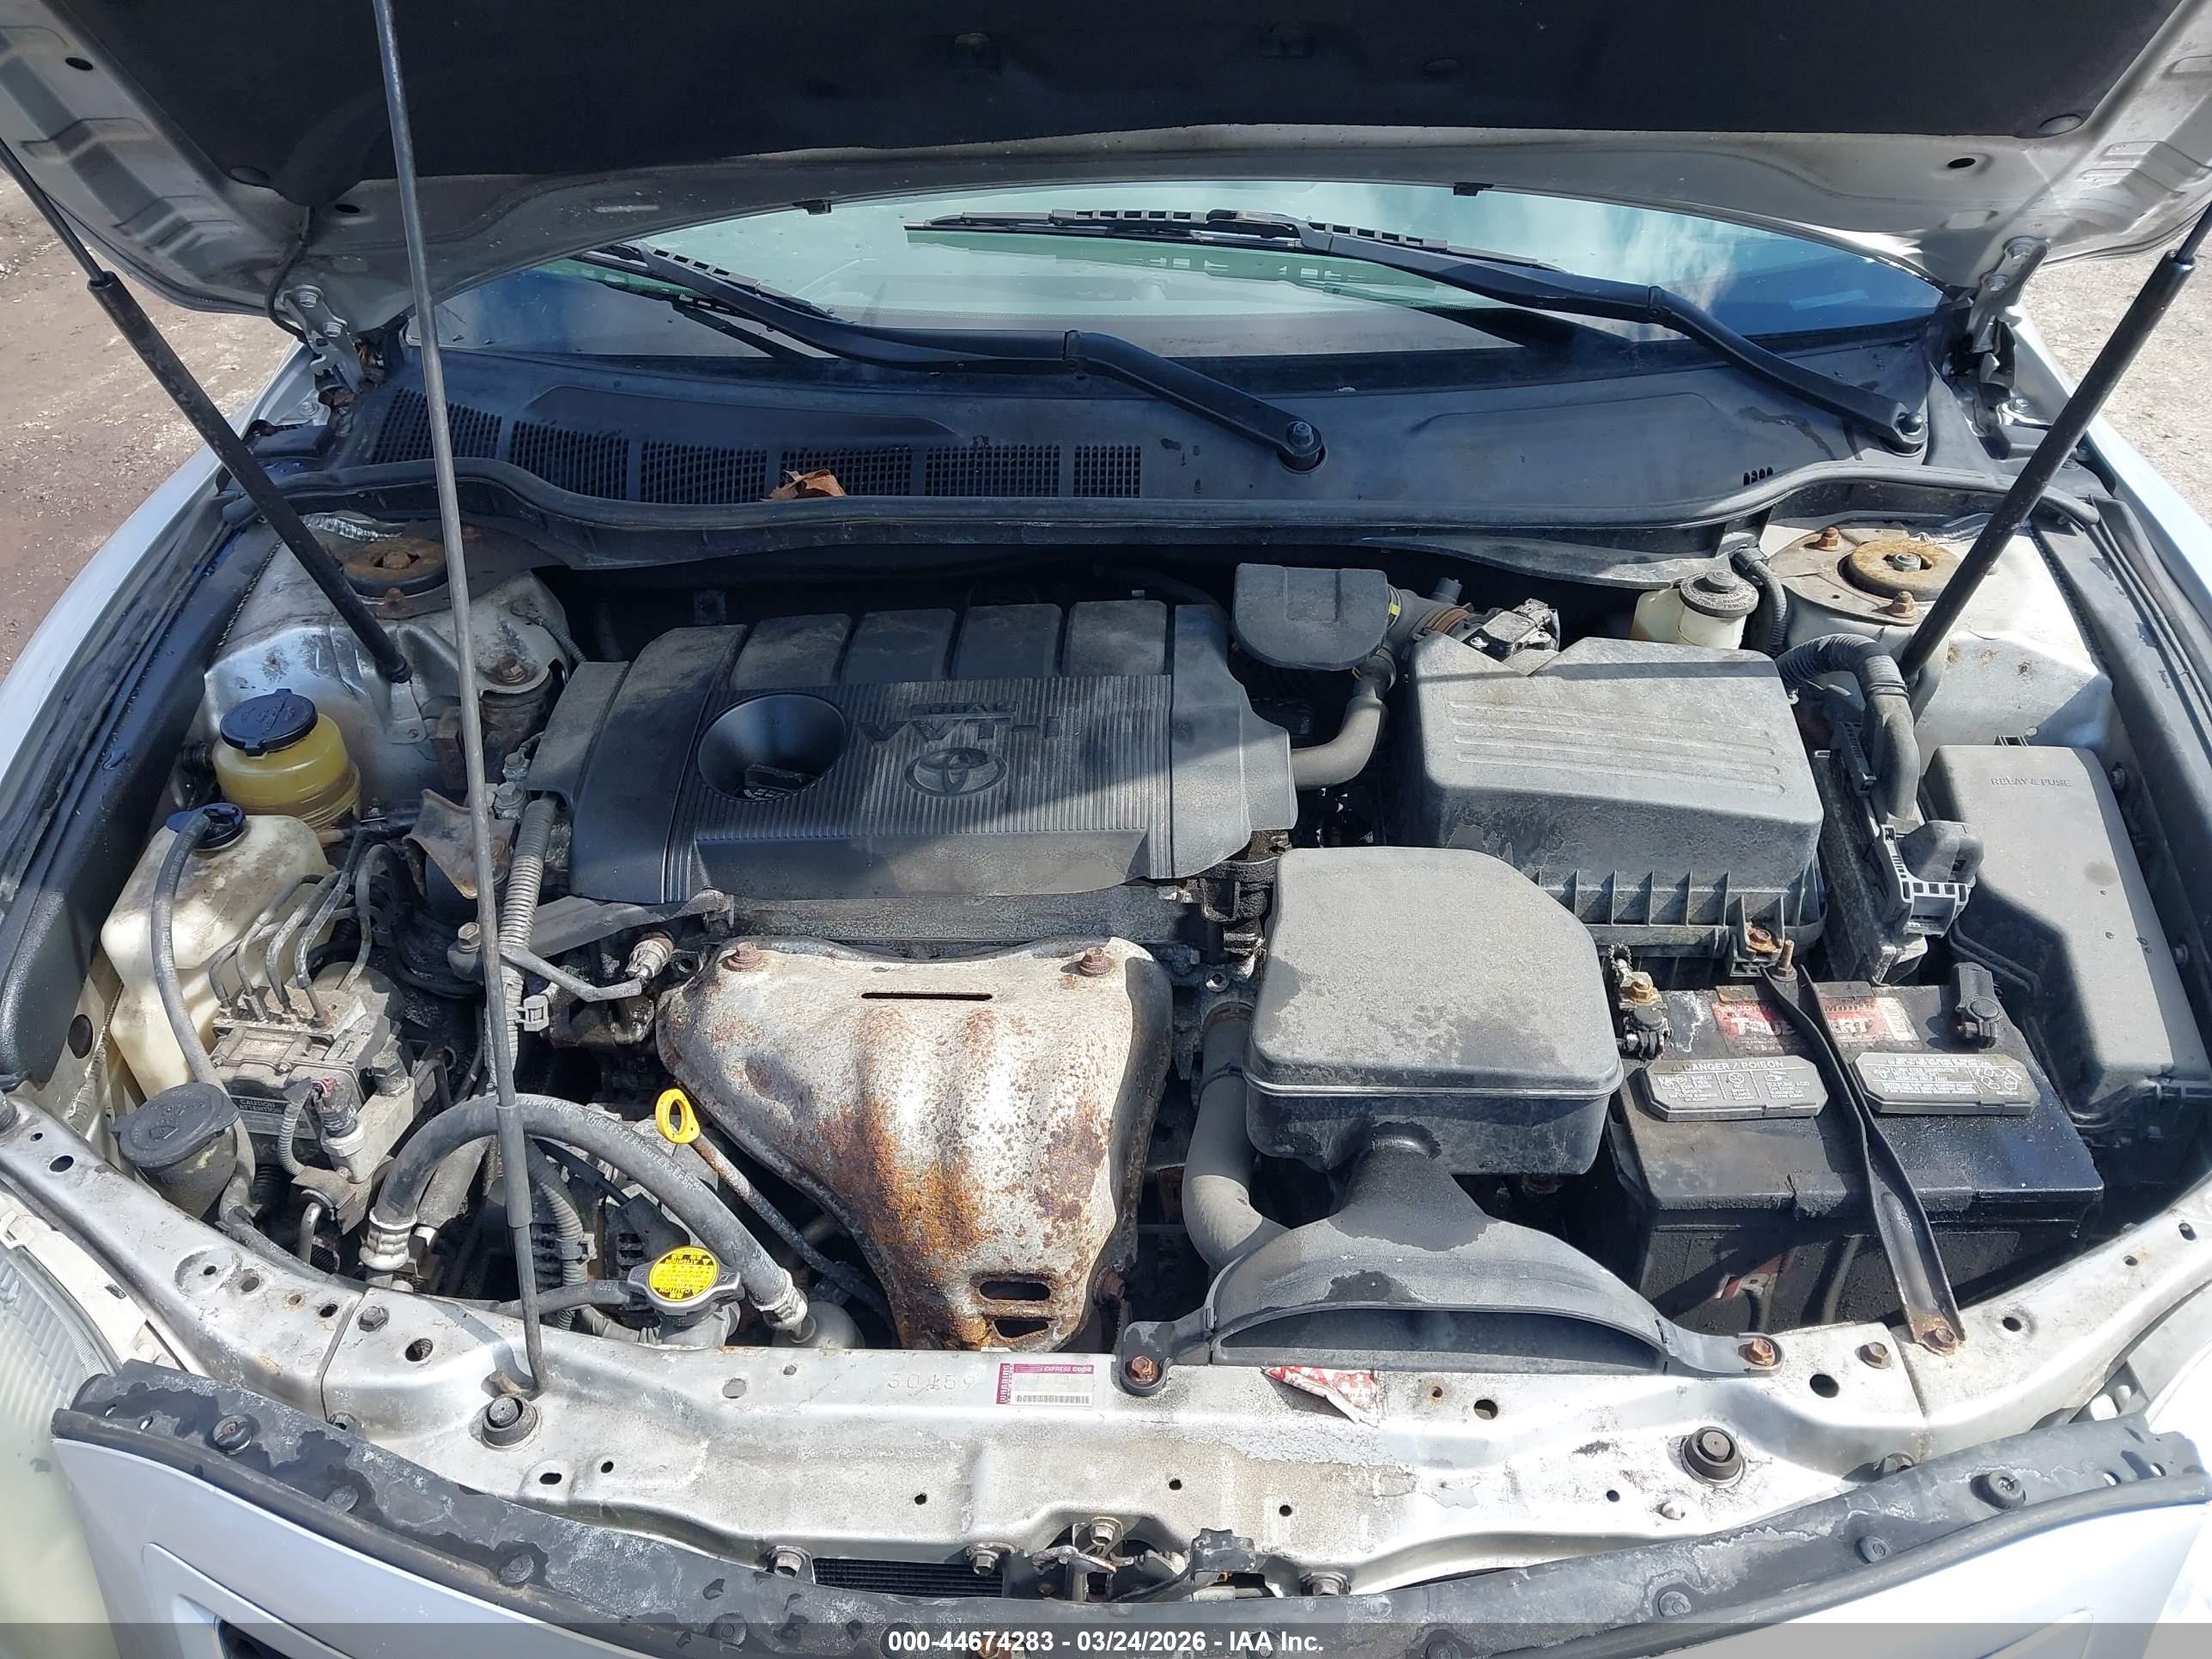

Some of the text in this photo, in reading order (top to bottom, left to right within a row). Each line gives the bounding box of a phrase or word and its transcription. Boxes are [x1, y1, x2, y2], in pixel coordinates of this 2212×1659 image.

[1990, 776, 2027, 786] RELAY
[2041, 778, 2073, 787] FUSE
[1682, 1062, 1729, 1072] DANGER
[1741, 1060, 1784, 1070] POISON
